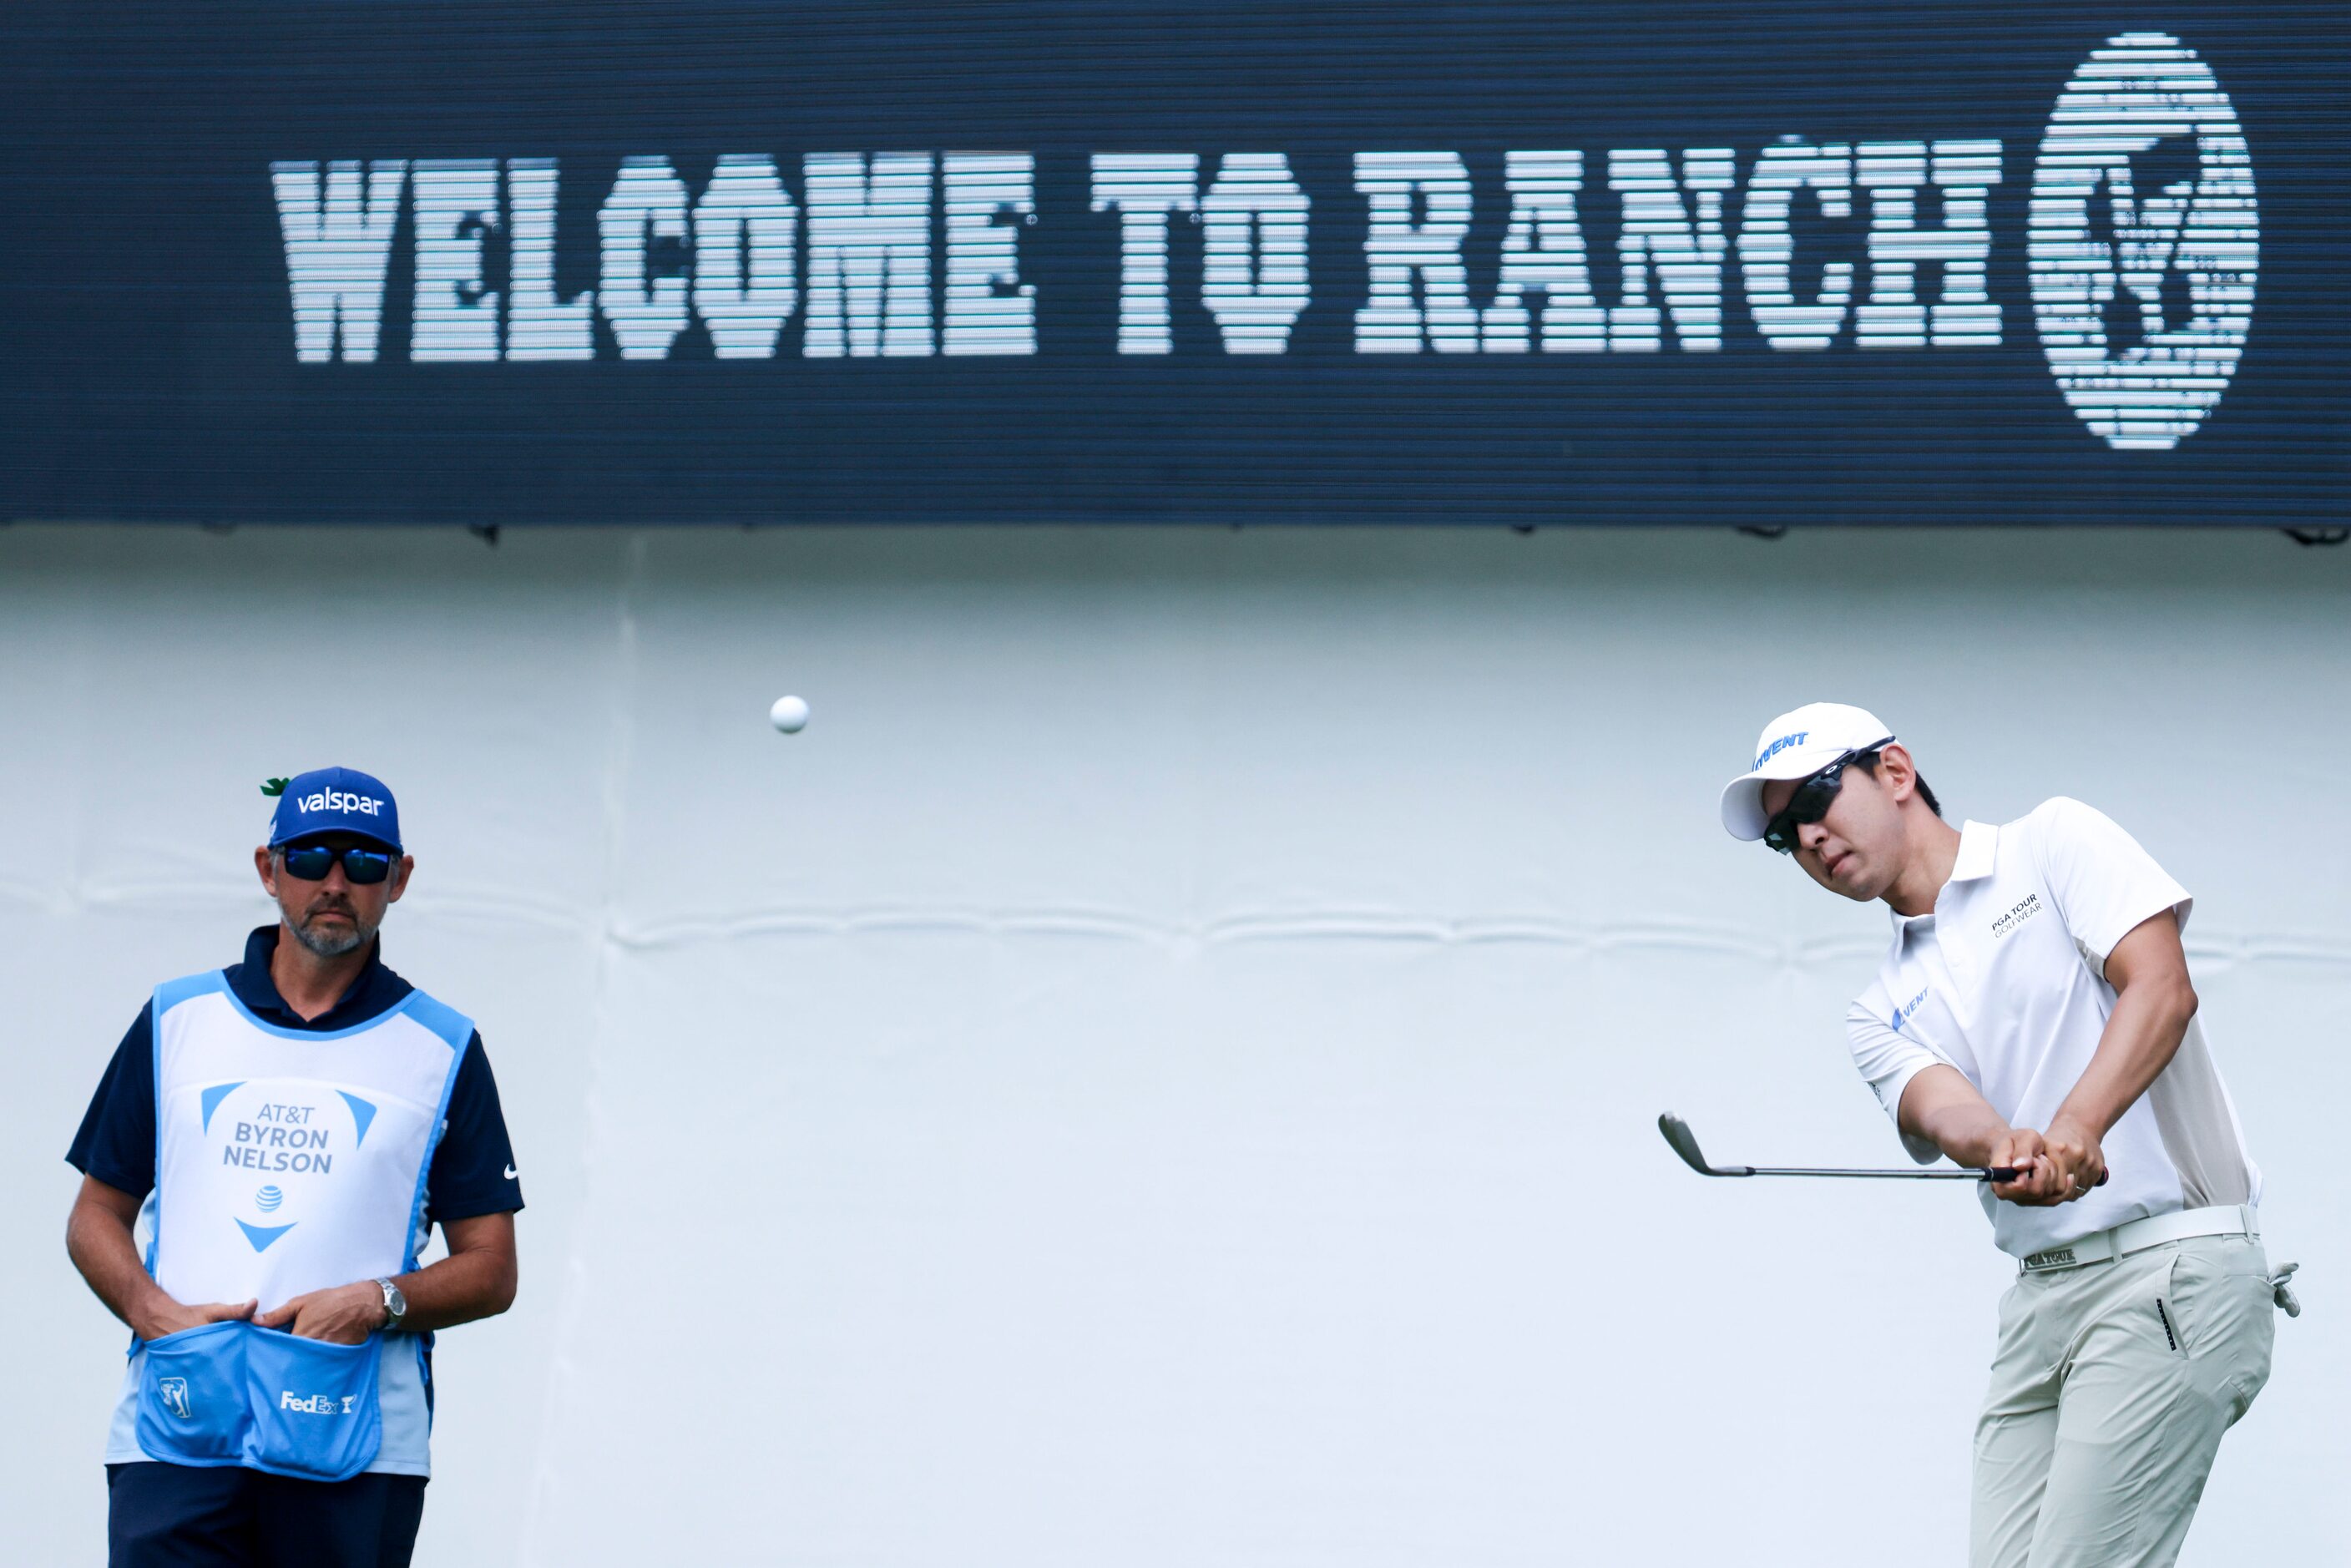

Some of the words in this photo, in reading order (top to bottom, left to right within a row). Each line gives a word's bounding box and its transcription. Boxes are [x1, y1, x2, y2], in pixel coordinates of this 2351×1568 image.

[269, 151, 1039, 363] WELCOME
[1090, 152, 1312, 356] TO
[1351, 134, 2004, 355] RANCH
[297, 786, 385, 818] valspar
[1991, 913, 2012, 932] PGA
[2011, 893, 2038, 916] TOUR
[1995, 902, 2043, 938] GOLFWEAR
[256, 1103, 316, 1125] AT&T
[234, 1121, 329, 1149] BYRON
[222, 1145, 333, 1174] NELSON
[280, 1390, 339, 1415] FedEx
